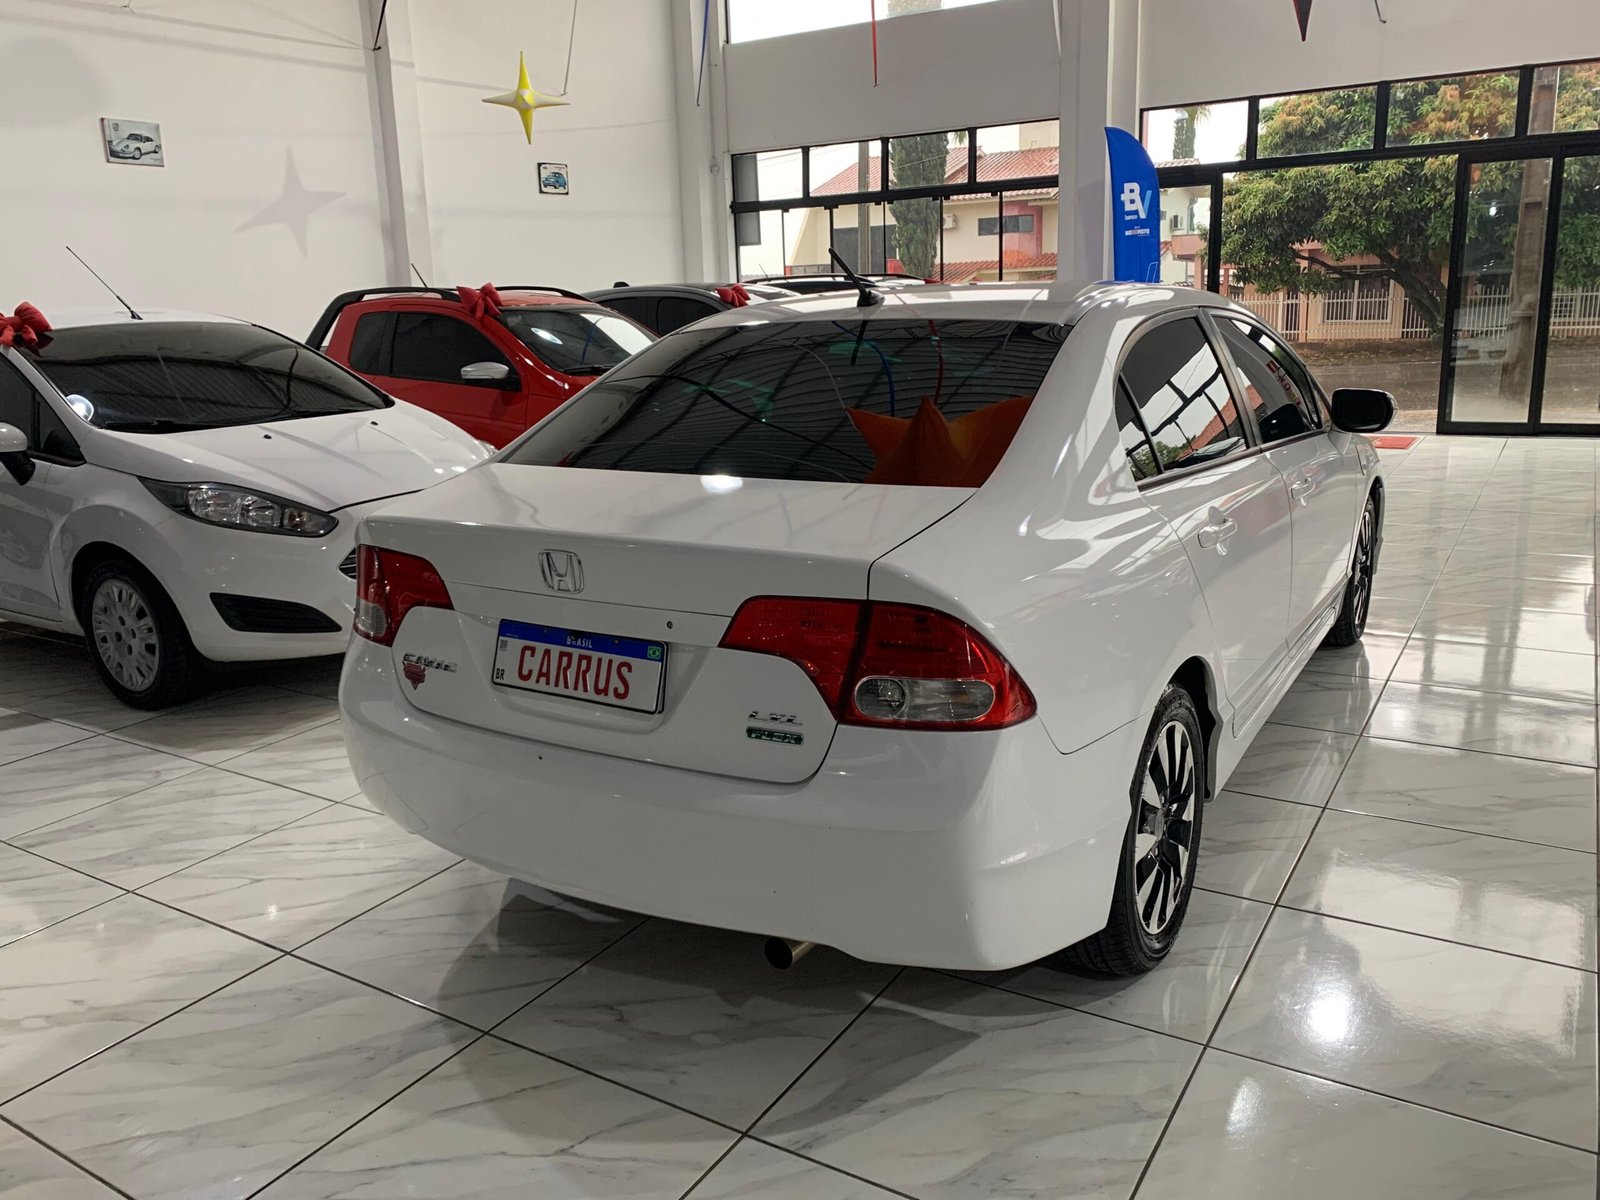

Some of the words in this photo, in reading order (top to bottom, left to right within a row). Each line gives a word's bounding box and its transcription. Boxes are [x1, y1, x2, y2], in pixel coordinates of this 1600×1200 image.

[1121, 182, 1152, 219] BV
[495, 668, 505, 681] BR
[517, 644, 633, 700] CARRUS
